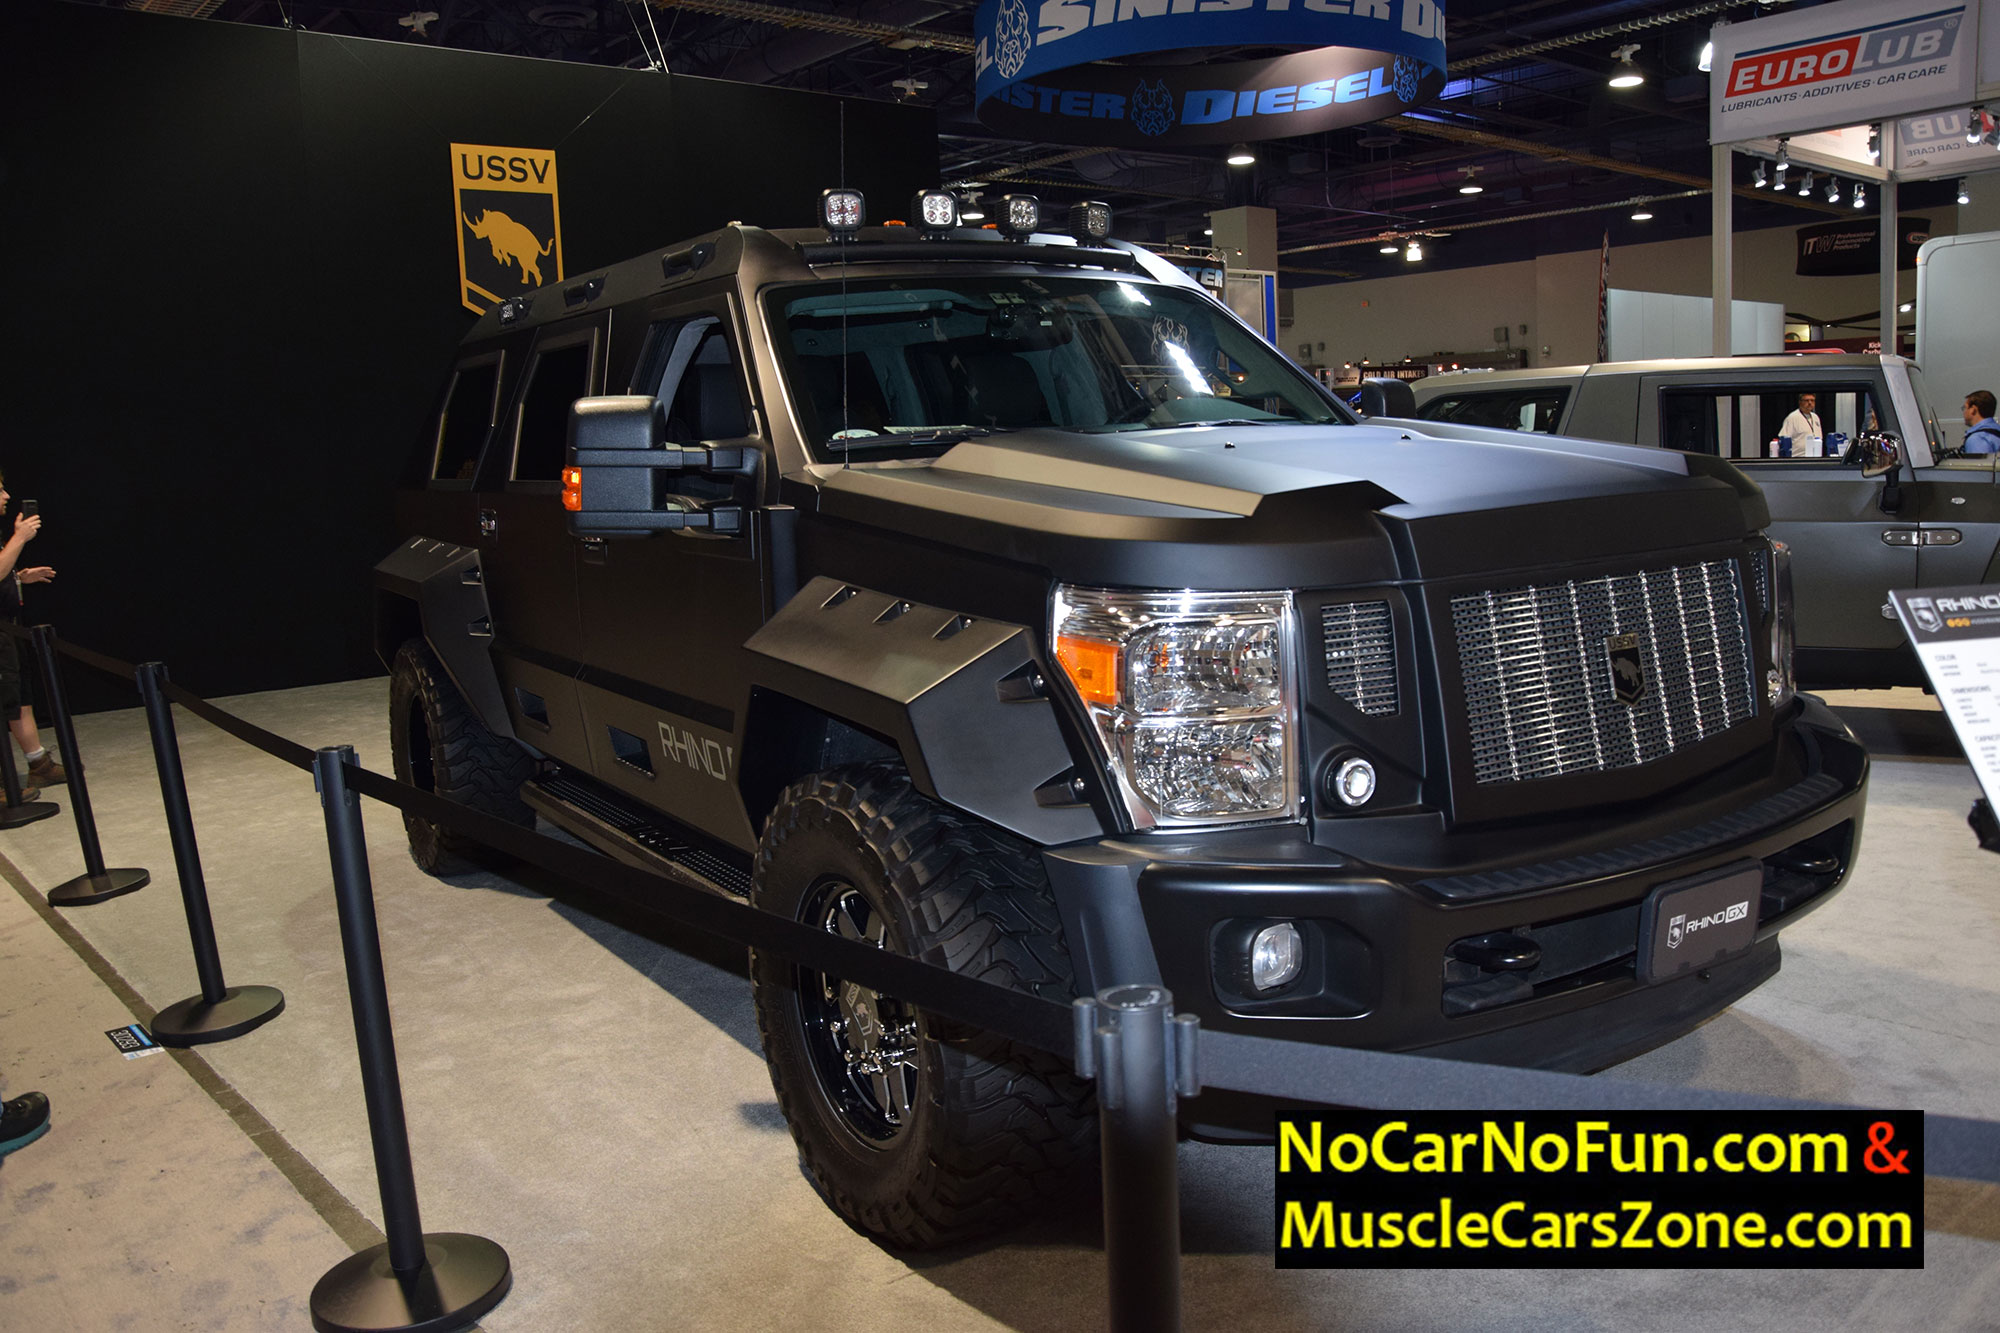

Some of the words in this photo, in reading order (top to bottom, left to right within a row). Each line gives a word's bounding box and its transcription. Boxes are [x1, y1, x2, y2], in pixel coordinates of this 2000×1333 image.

[1181, 67, 1392, 125] DIESEL
[1721, 92, 1797, 113] LUBRICANTS
[1802, 79, 1870, 98] ADDITIVES
[1877, 71, 1906, 86] CAR
[1908, 64, 1947, 80] CARE
[461, 153, 550, 184] USSV
[1363, 370, 1380, 379] COLD
[1383, 370, 1395, 379] AIR
[1397, 369, 1425, 379] INTAKES
[1609, 634, 1636, 649] USSV
[657, 721, 726, 781] RHINO
